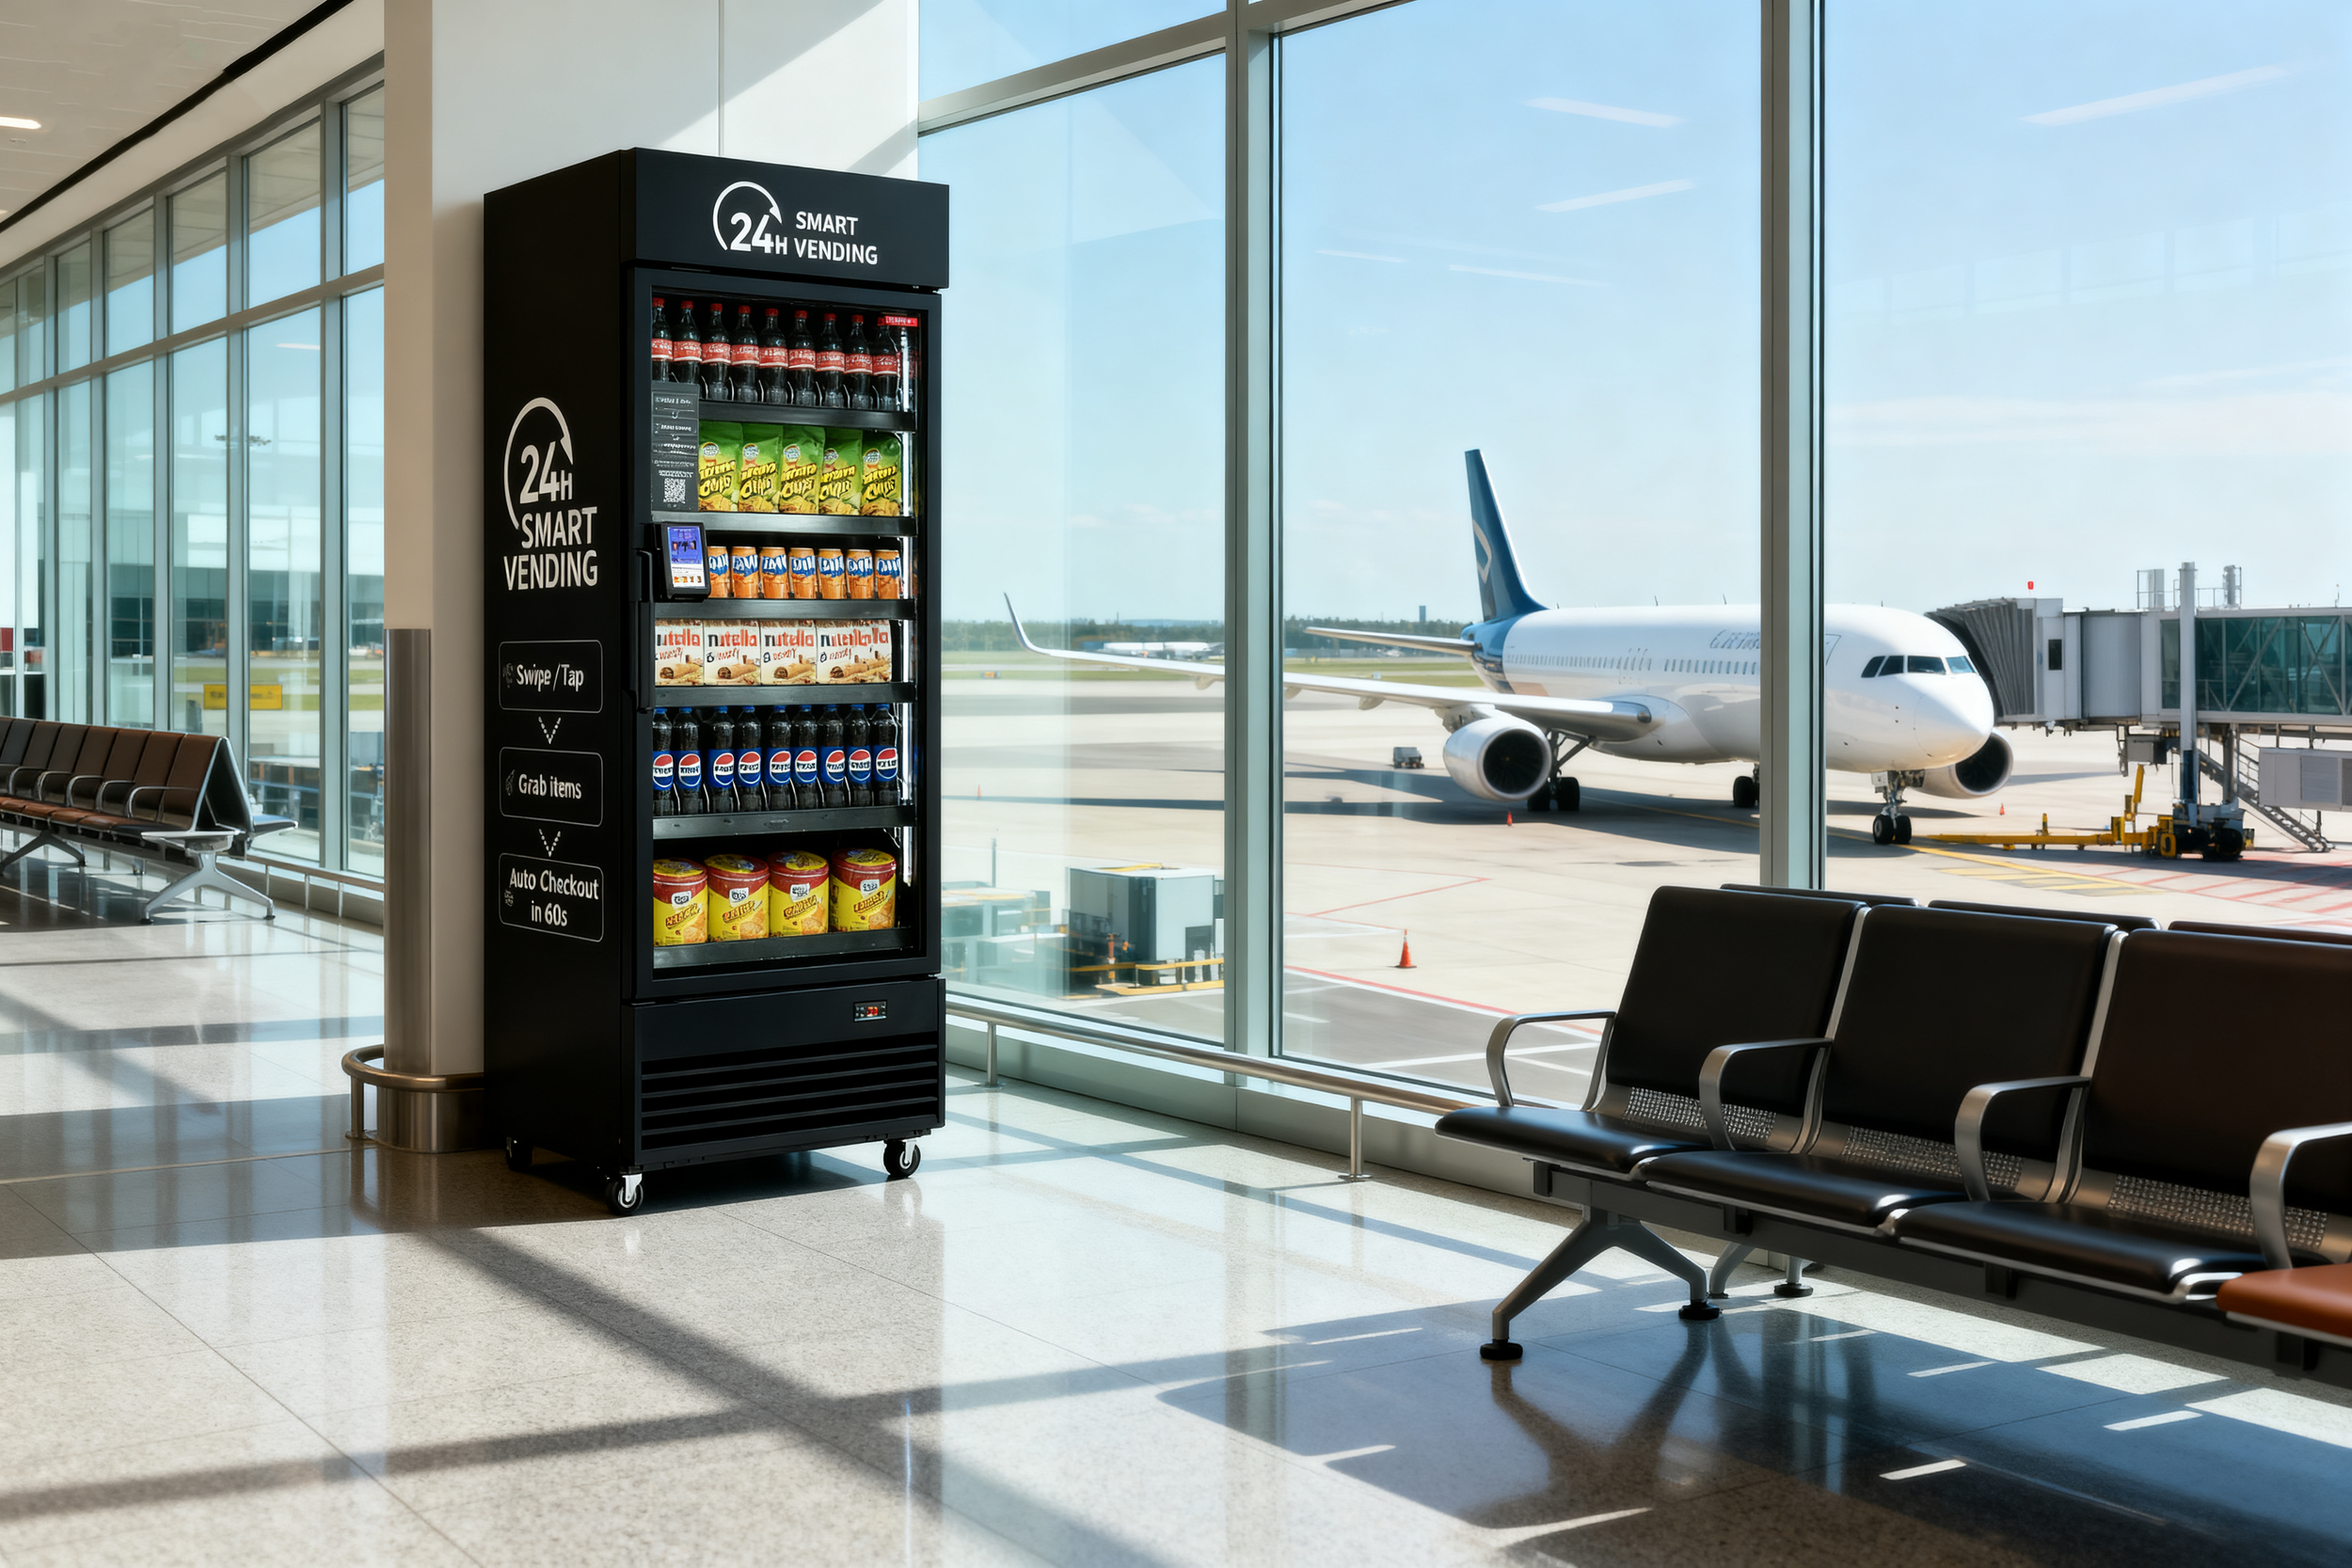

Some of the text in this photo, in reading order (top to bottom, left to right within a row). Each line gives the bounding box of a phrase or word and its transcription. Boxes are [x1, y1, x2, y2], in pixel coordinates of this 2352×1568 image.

[729, 212, 788, 256] 24H
[795, 211, 859, 236] SMART
[793, 237, 879, 265] VENDING
[519, 440, 574, 504] 24H
[521, 506, 598, 549] SMART
[503, 549, 598, 591] VENDING
[516, 663, 552, 692] Swipe
[518, 773, 582, 800] Grab items
[509, 867, 599, 900] Auto Checkout
[531, 900, 568, 927] in 60s
